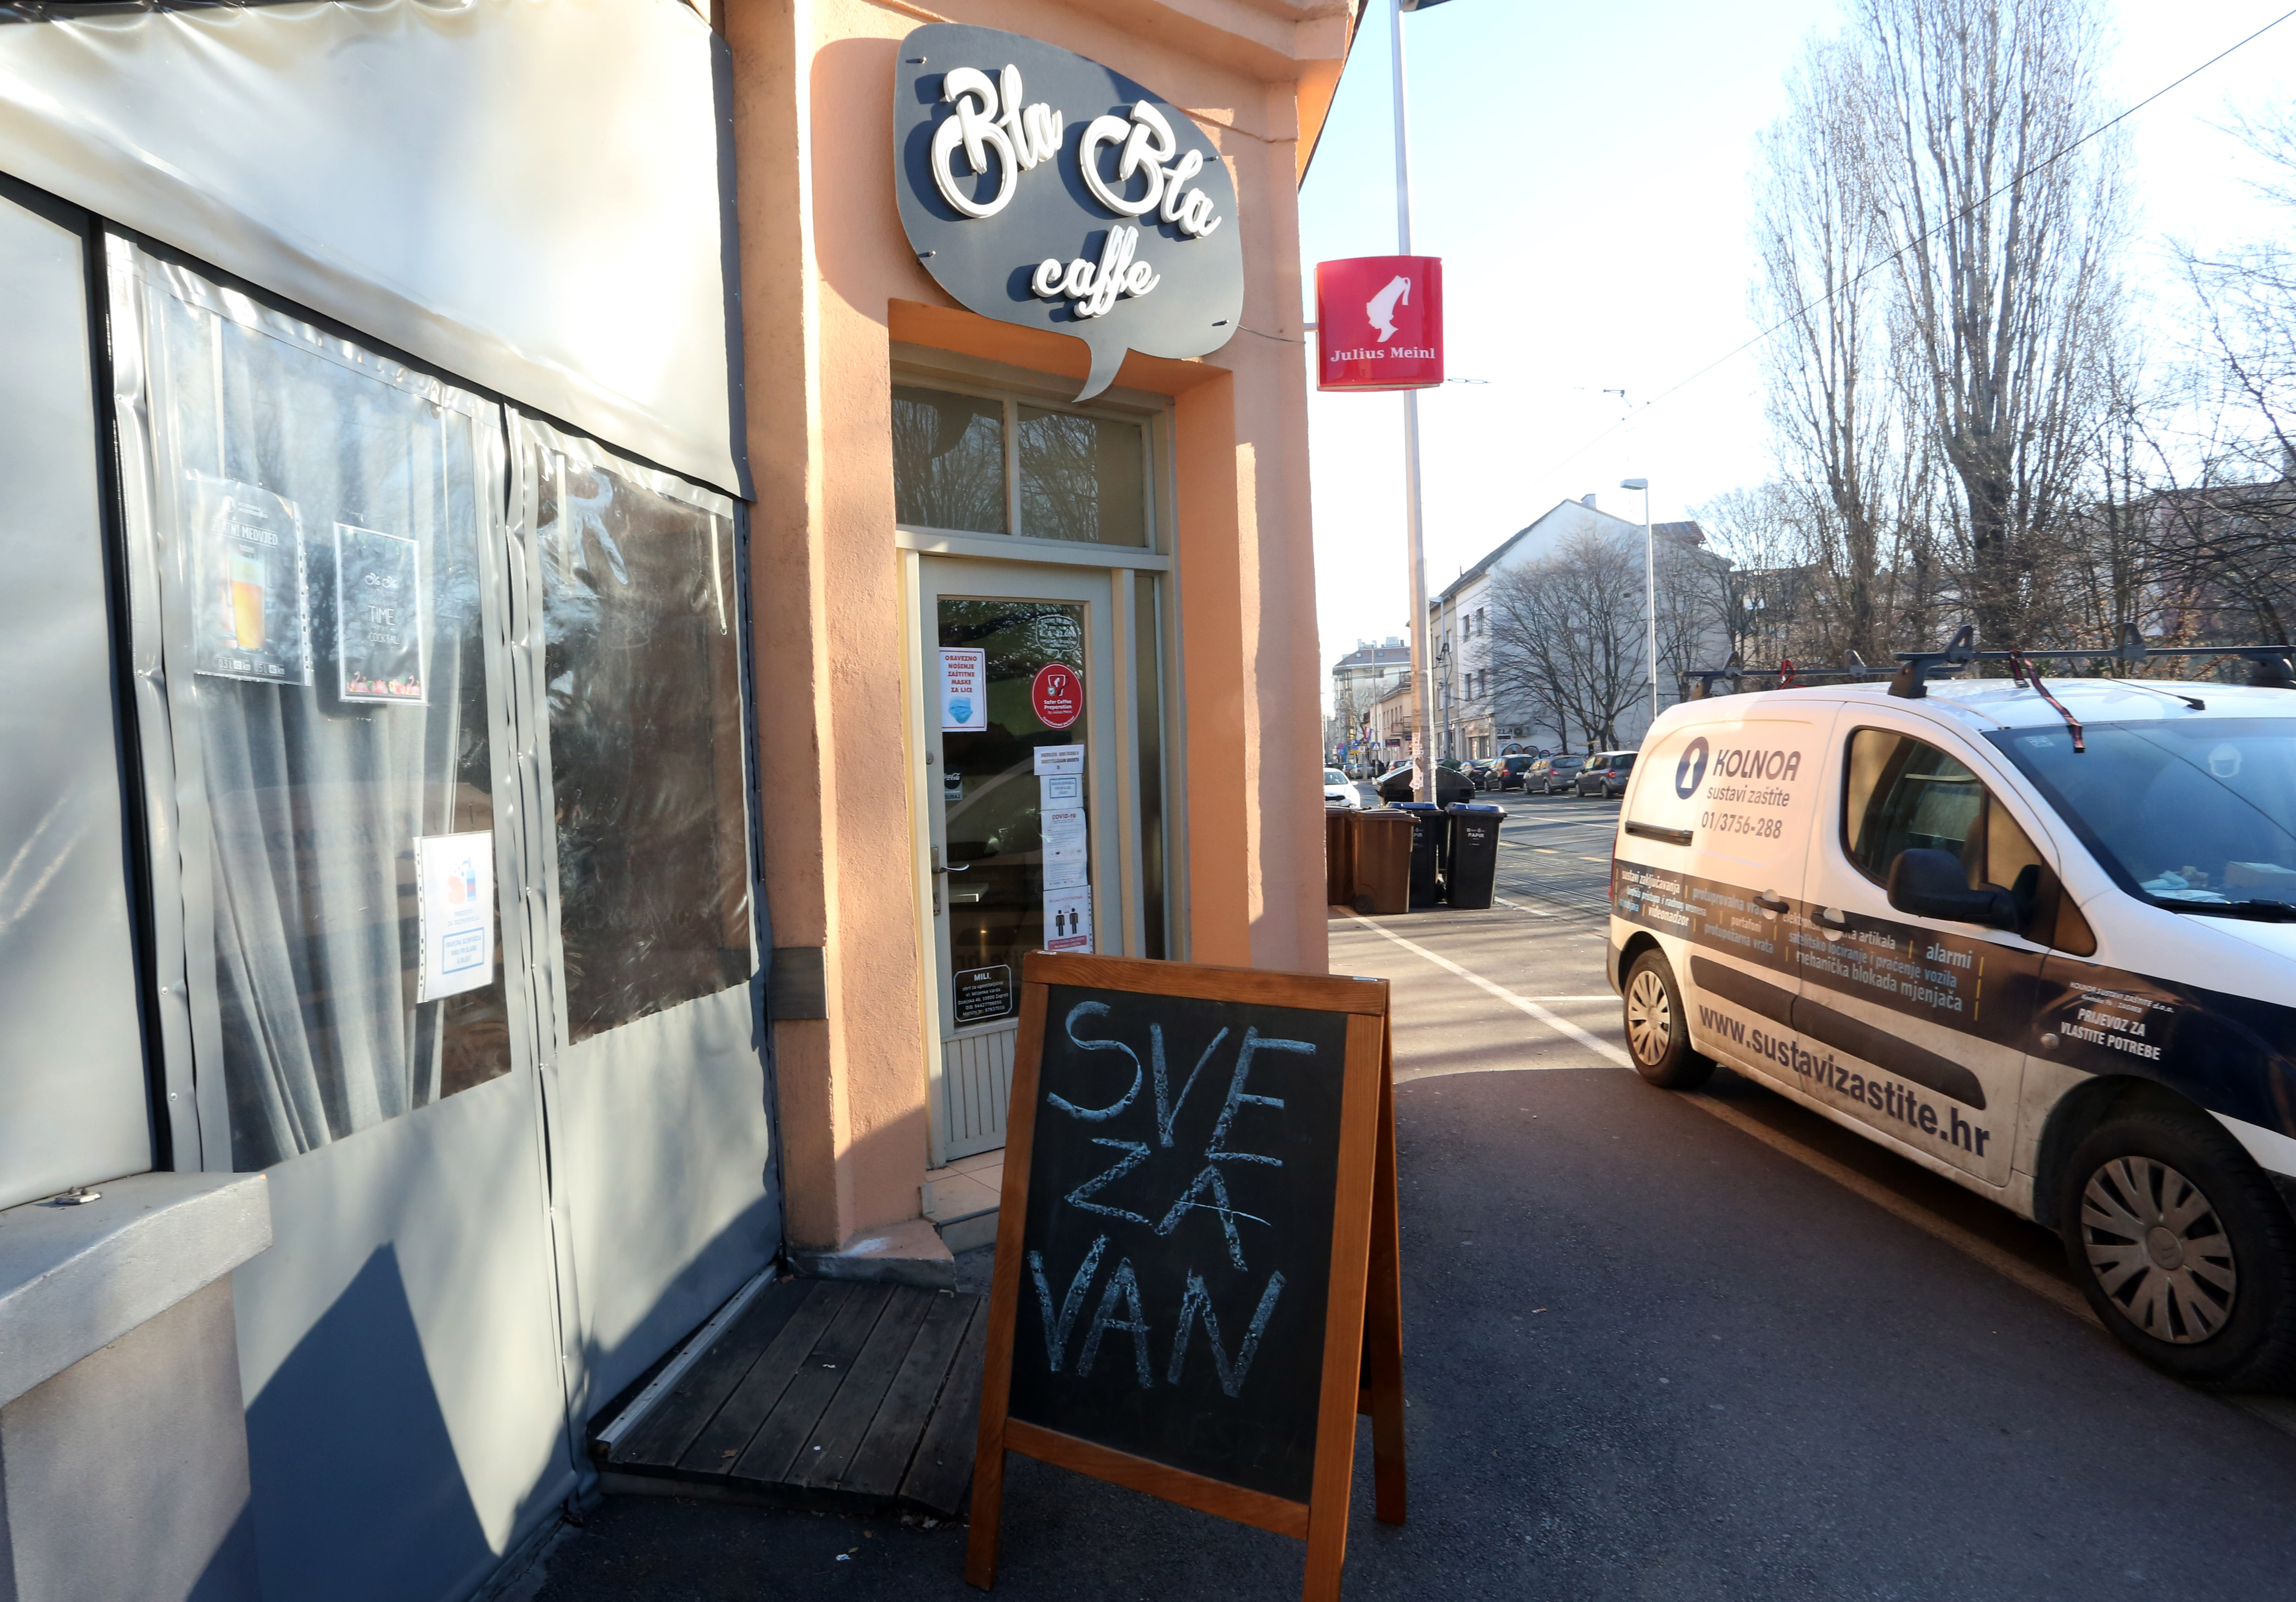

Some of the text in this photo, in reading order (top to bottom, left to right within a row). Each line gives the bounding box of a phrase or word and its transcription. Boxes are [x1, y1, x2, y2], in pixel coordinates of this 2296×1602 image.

[931, 63, 1221, 239] Bla Bla
[1031, 225, 1160, 317] caffe
[1330, 347, 1435, 362] Julius Meinl
[242, 526, 278, 545] MEDVJED
[368, 605, 396, 625] TIME
[1707, 784, 1789, 807] sustavi zaštite
[1702, 811, 1782, 839] 01/3756-288
[1622, 870, 1680, 895] sustavi zaključavanja
[1693, 888, 1744, 911] protuprovalna
[1649, 902, 1689, 926] videonadzor
[1705, 923, 1774, 954] protupožarna vrata
[1859, 930, 1896, 950] artikala
[1789, 932, 1826, 951] satelitsko
[1828, 941, 1867, 963] lociranje
[1870, 951, 1874, 965] i
[1876, 957, 1921, 979] praćenje
[1924, 968, 1957, 988] vozila
[1926, 942, 1973, 969] alarmi
[974, 973, 991, 981] MILI.
[1796, 951, 1962, 1012] mehanička blokada mjenjača
[2097, 988, 2123, 1000] SUSTAVI
[2123, 995, 2153, 1007] ZAŠTITE
[2077, 1008, 2146, 1037] PRIJEVOZ ZA
[2061, 1021, 2162, 1061] VLASTITE POTREBE
[1047, 1001, 1316, 1165] SVE
[1699, 1004, 1990, 1158] www.sustavizastite.hr
[1064, 1138, 1272, 1273] ZA
[1027, 1235, 1286, 1398] VAN
